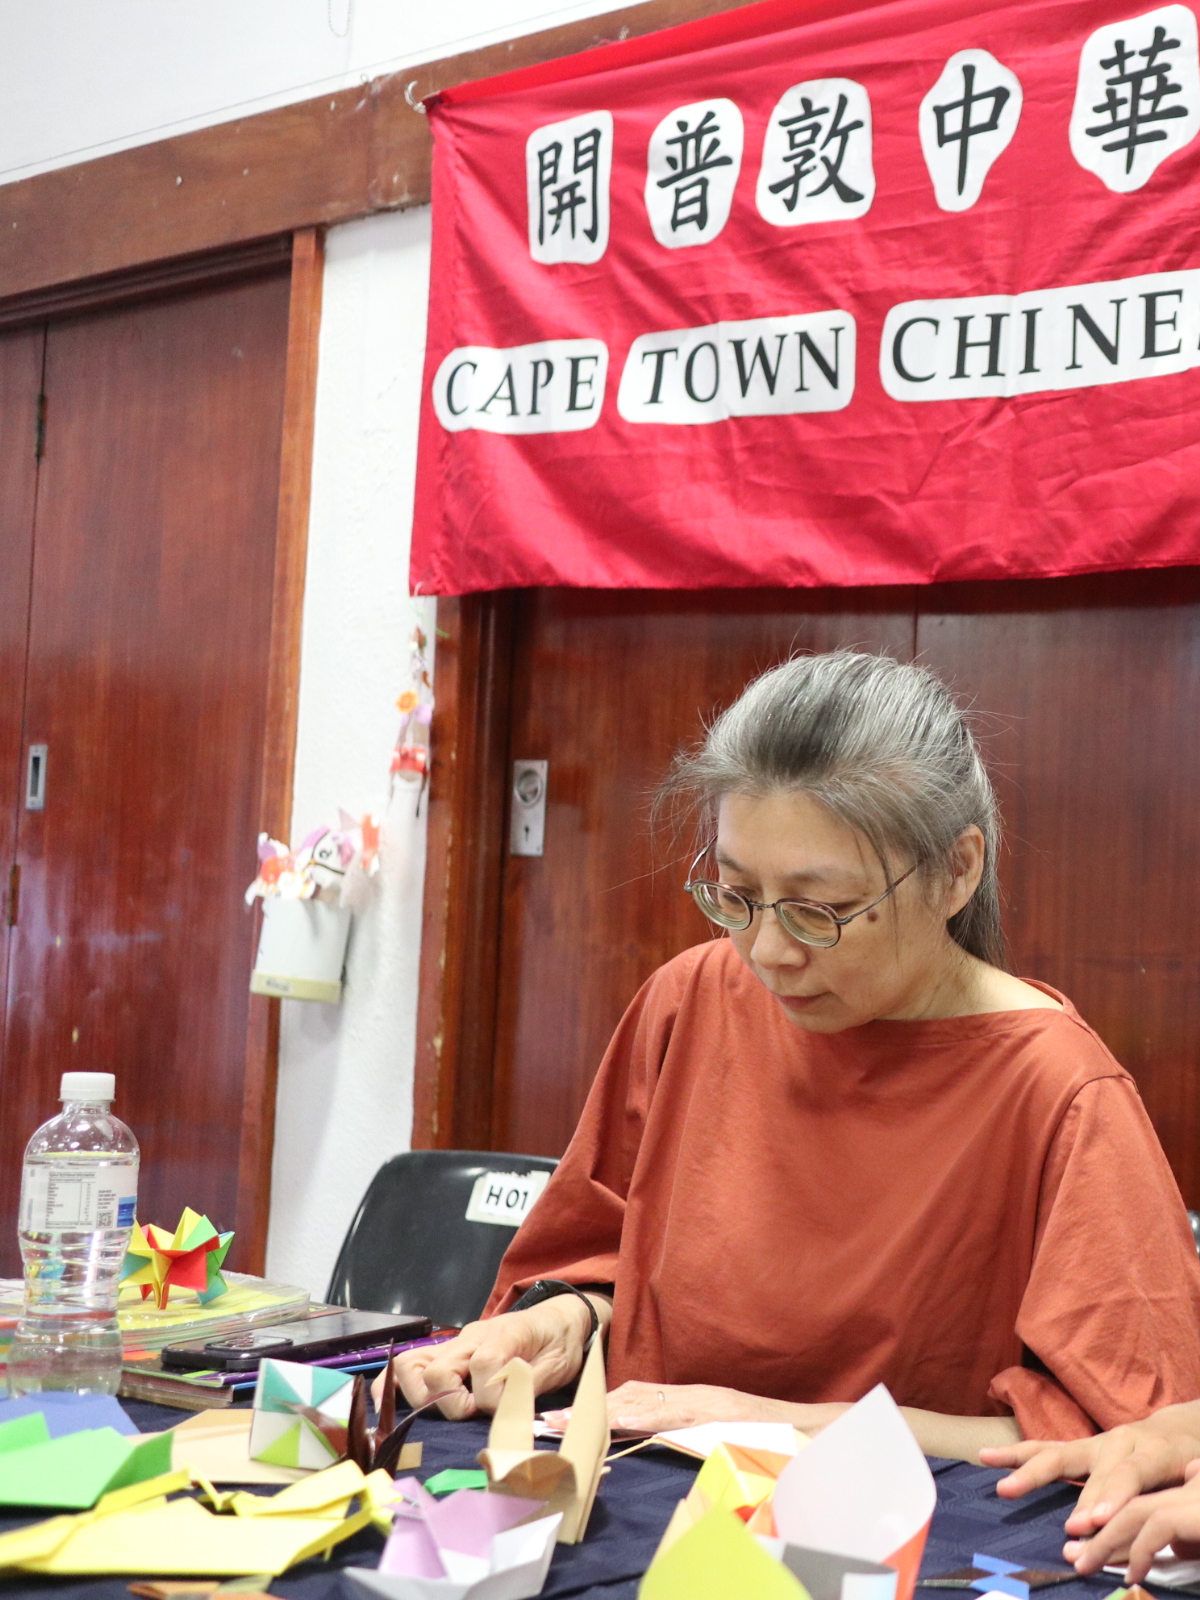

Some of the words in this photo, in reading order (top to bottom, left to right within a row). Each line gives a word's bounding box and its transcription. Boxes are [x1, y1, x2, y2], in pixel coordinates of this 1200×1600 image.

[445, 355, 599, 417] CAPE
[641, 326, 846, 405] TOWN
[485, 1184, 528, 1211] H01
